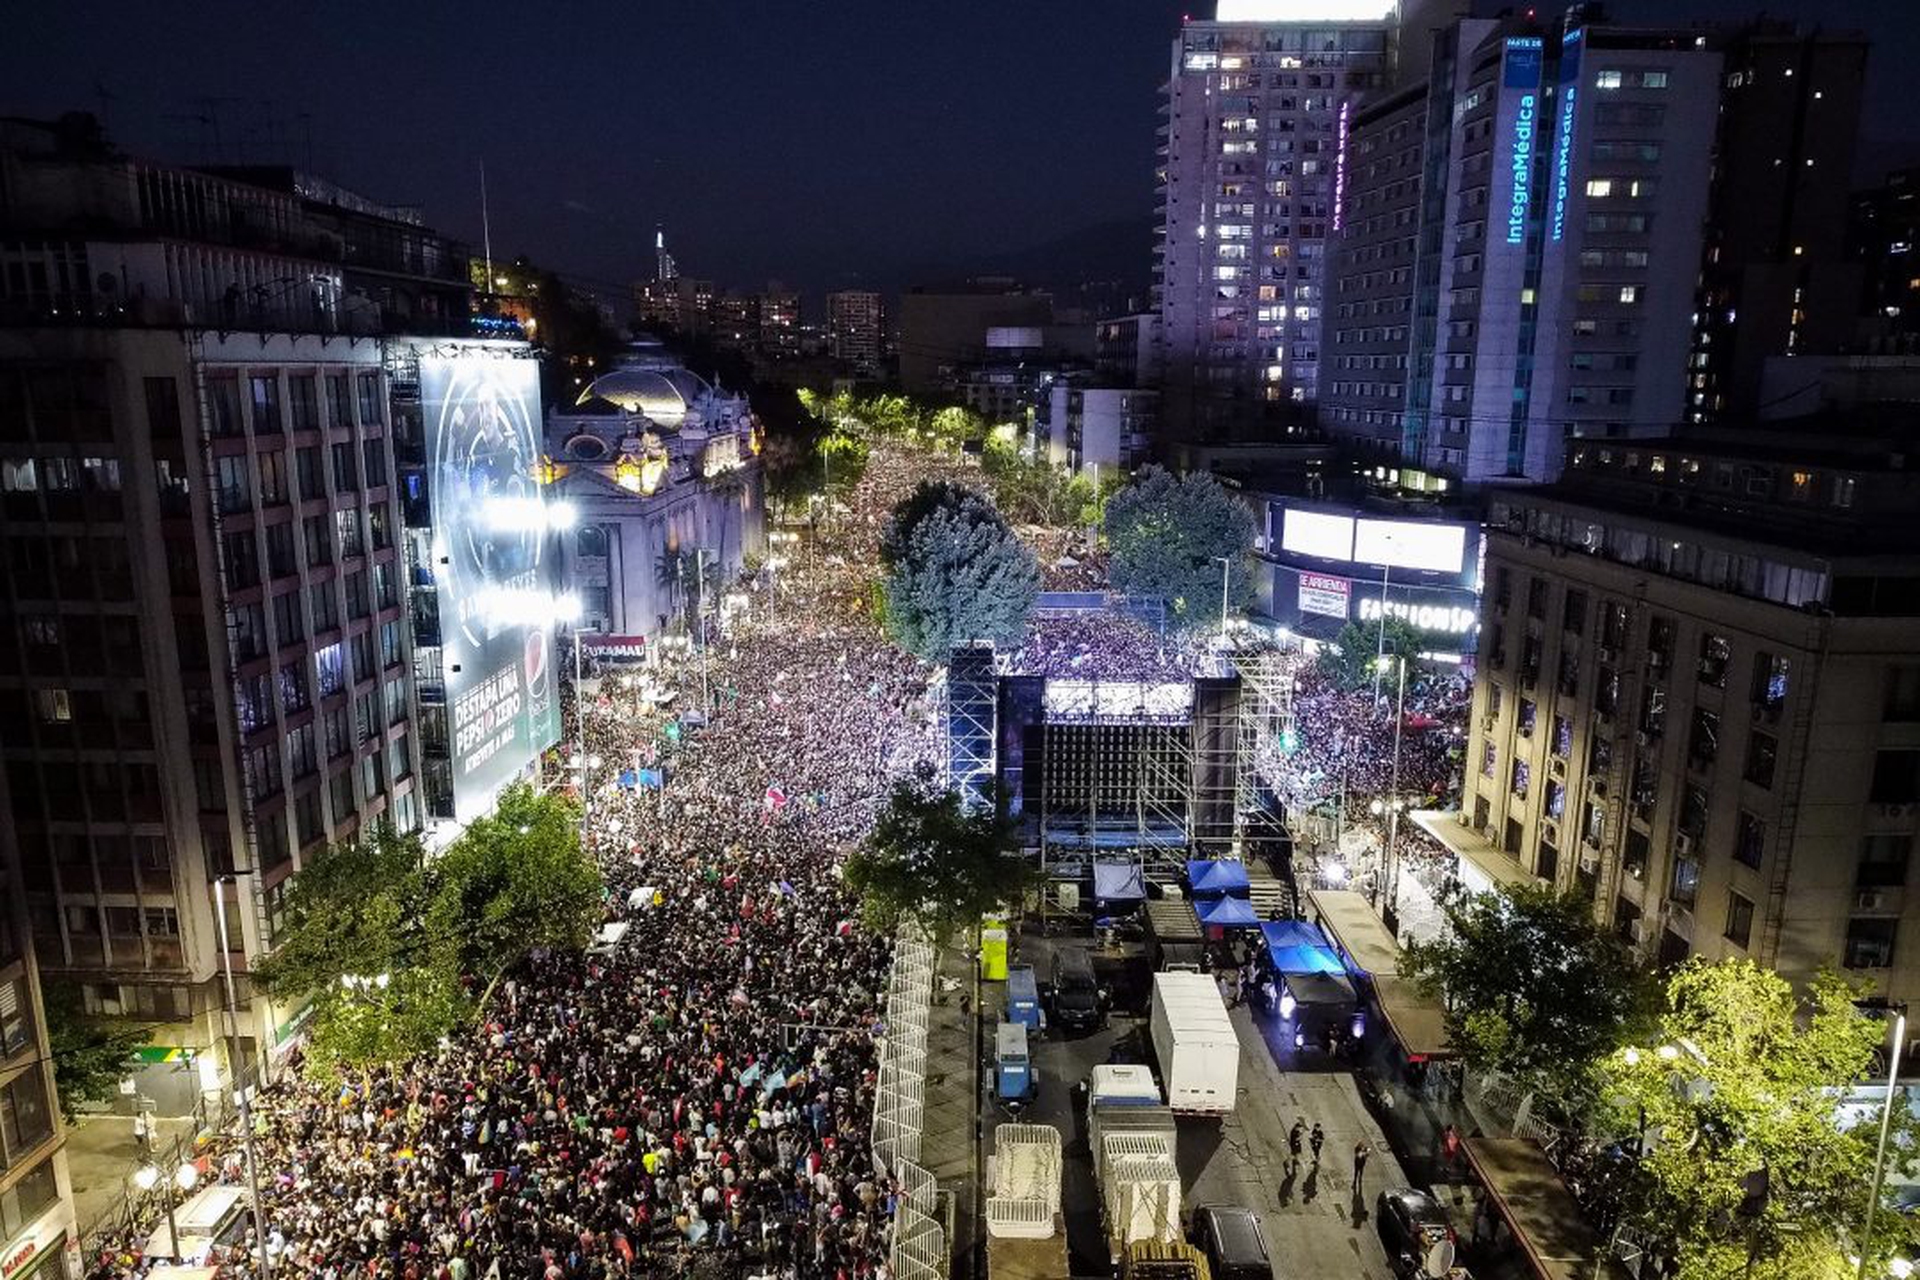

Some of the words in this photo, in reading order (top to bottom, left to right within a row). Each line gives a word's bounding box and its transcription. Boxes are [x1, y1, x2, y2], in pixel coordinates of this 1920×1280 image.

[1507, 95, 1534, 243] IntegraMédica
[1552, 88, 1575, 241] IntegraMédica
[455, 677, 499, 729] DESTAPA
[499, 664, 519, 701] UNA
[456, 716, 484, 756] PEPSI
[495, 692, 520, 728] ZERO
